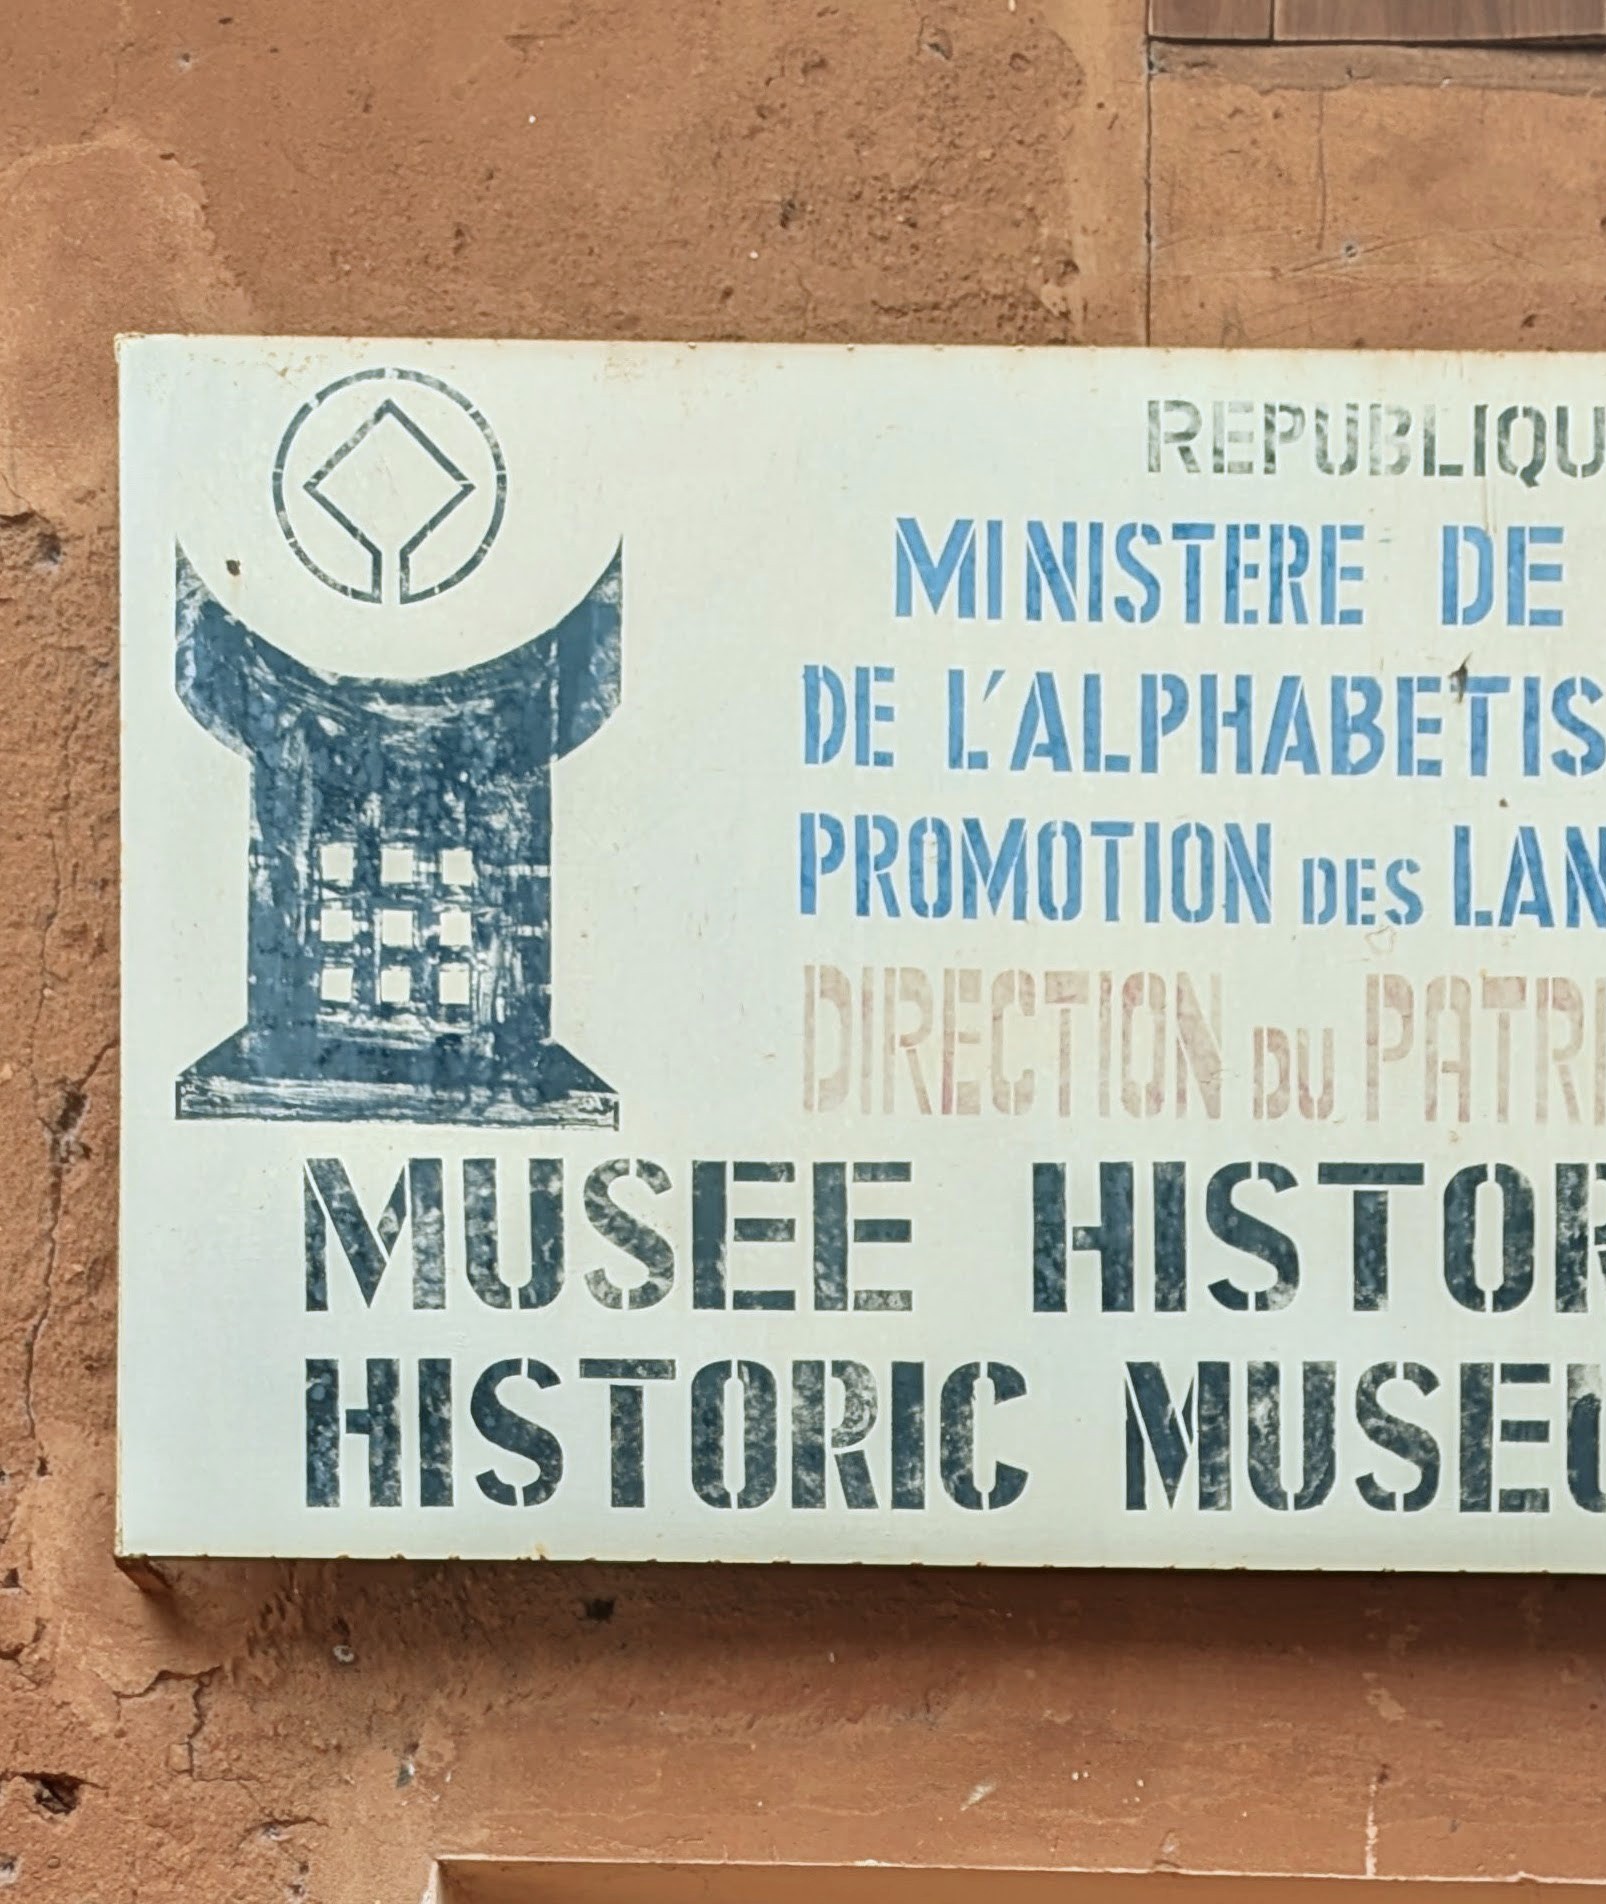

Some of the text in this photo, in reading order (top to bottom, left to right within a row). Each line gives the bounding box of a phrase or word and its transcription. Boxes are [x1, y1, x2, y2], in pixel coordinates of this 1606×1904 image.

[895, 516, 1366, 626] MINISTERE
[1441, 522, 1566, 628] DE
[801, 664, 895, 768] DE
[799, 812, 1272, 926] PROMOTION
[1302, 857, 1424, 927] DES
[803, 964, 1223, 1120] DIRECTION
[1252, 1026, 1337, 1120] DU
[303, 1158, 914, 1313] MUSEE
[304, 1357, 1030, 1511] HISTORIC
